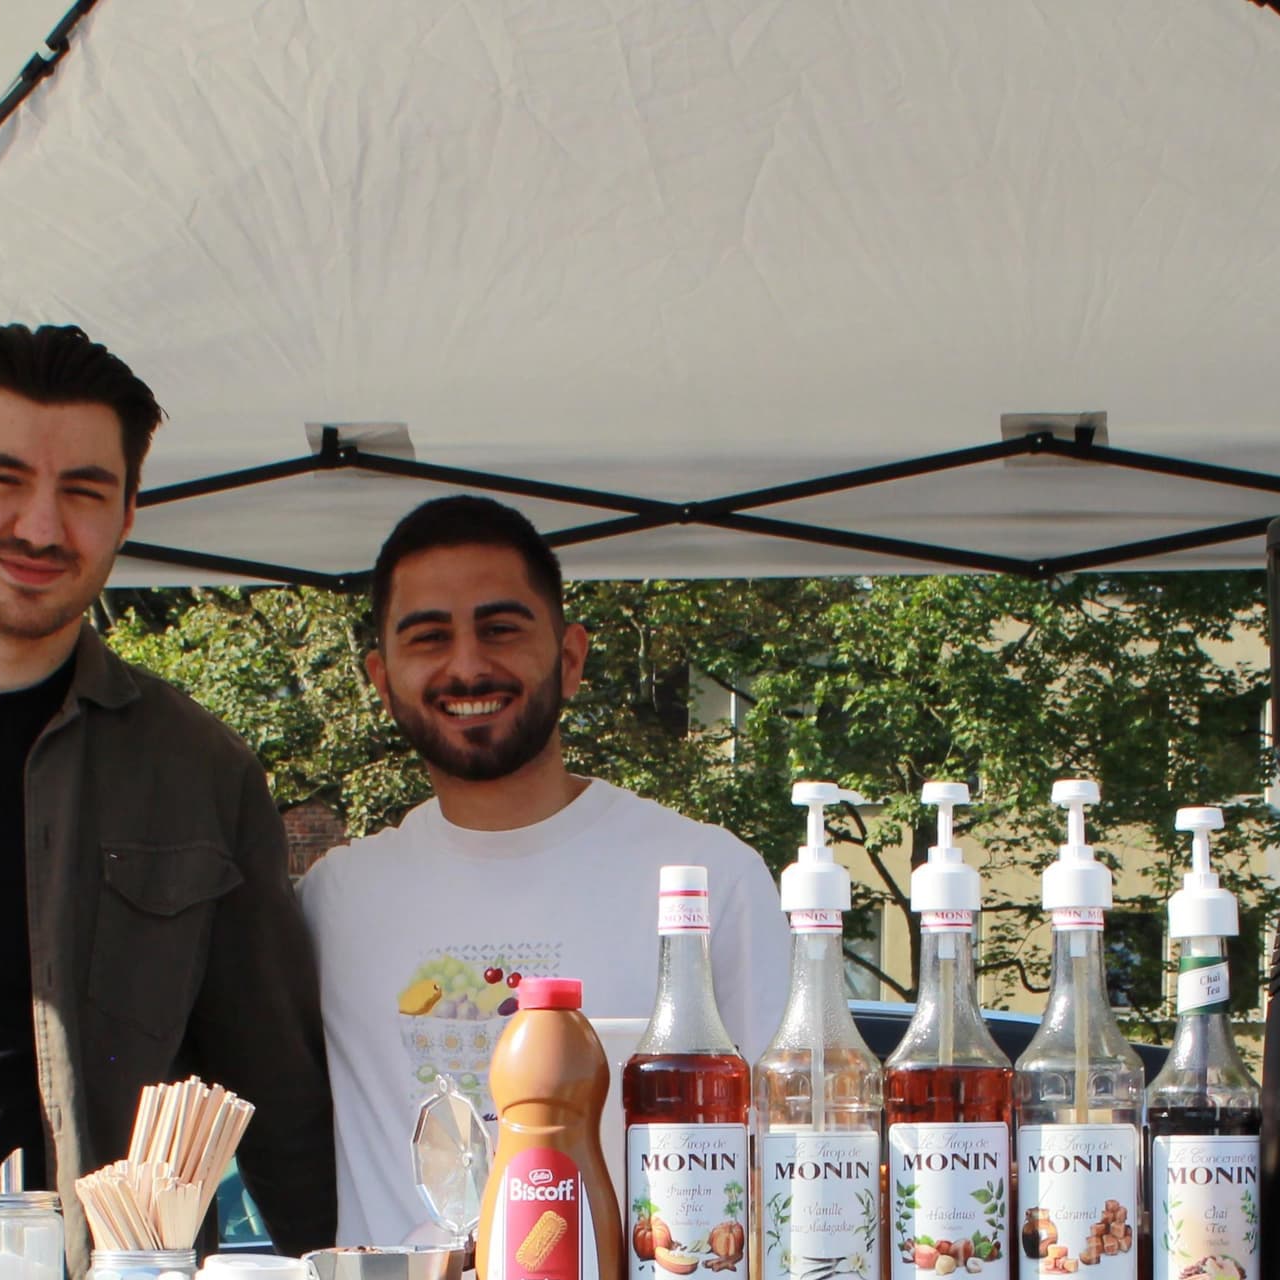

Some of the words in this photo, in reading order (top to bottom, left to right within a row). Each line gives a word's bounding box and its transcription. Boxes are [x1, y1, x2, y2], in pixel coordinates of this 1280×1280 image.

[1200, 972, 1221, 985] Chai
[641, 1153, 737, 1172] MONIN
[903, 1152, 999, 1172] MONIN
[1028, 1155, 1123, 1174] MONIN
[775, 1161, 870, 1181] MONIN
[1166, 1166, 1258, 1186] MONIN
[510, 1178, 574, 1201] Biscoff
[666, 1183, 712, 1199] Pumpkin
[676, 1201, 704, 1216] Spice
[802, 1203, 843, 1216] Vanille
[926, 1206, 976, 1222] Haselnuss
[1055, 1205, 1097, 1221] Caramel
[1204, 1205, 1228, 1219] Chai
[805, 1219, 855, 1236] Madagaskar
[1205, 1222, 1227, 1233] Tee
